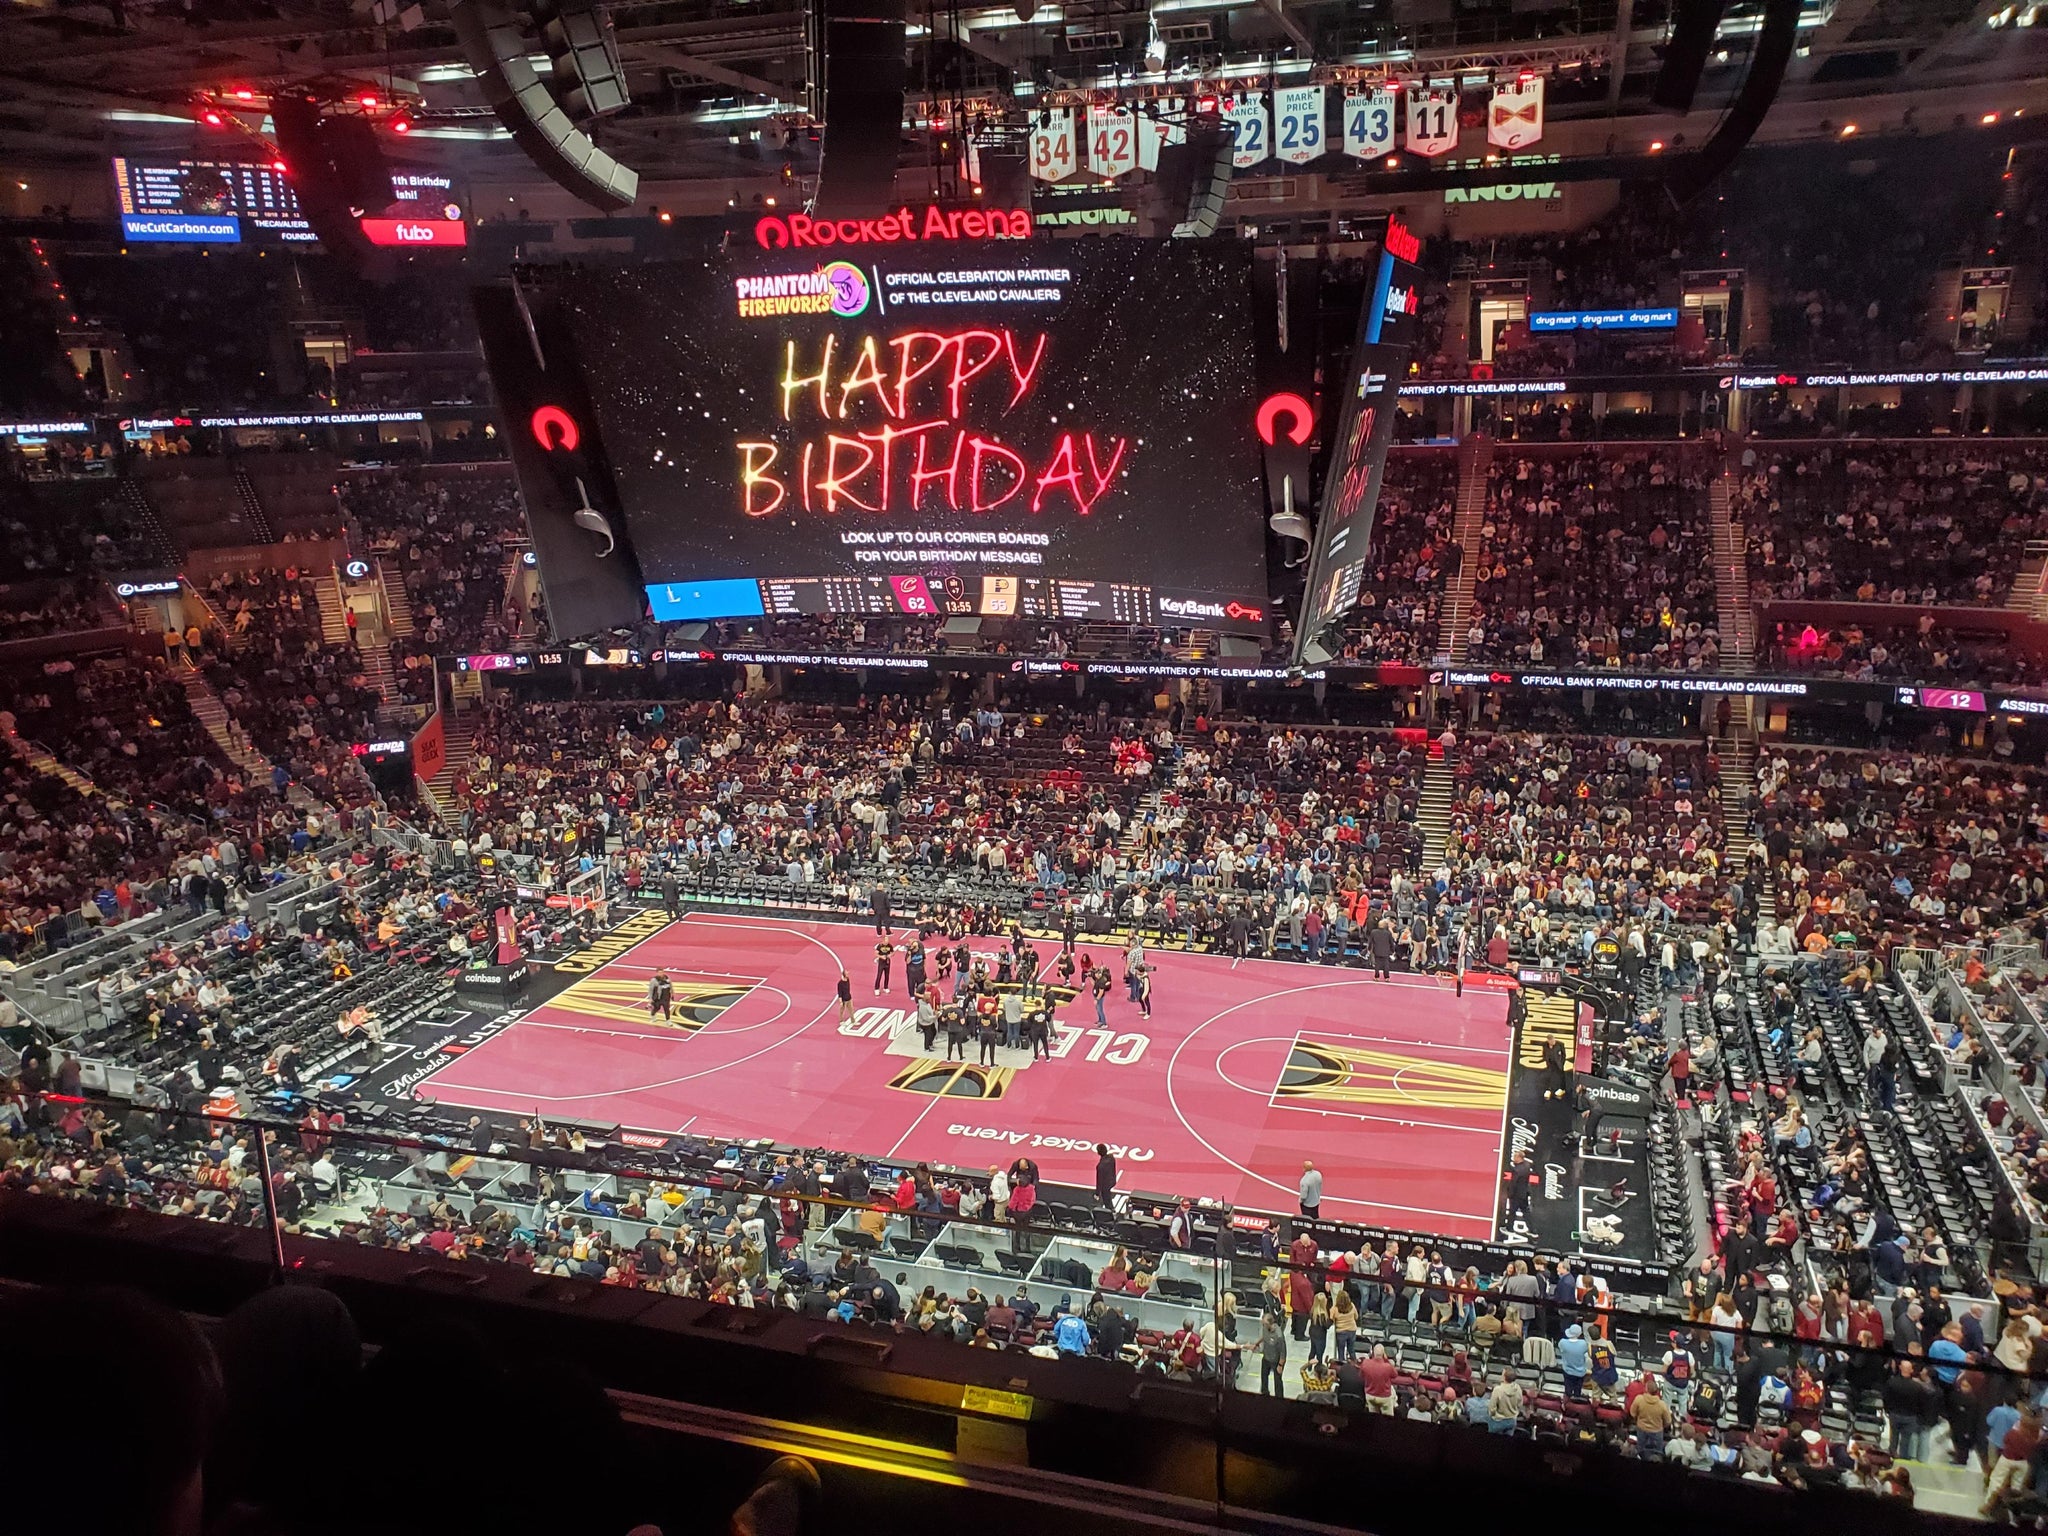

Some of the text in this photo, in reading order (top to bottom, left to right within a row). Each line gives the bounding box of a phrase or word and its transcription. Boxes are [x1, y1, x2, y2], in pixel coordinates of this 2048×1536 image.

[1287, 93, 1313, 103] MARK
[1346, 97, 1394, 108] DAUGHERTY
[1228, 107, 1259, 117] NANCE
[1287, 102, 1313, 112] PRICE
[1350, 109, 1388, 143] 43
[1416, 106, 1447, 139] 11
[1282, 114, 1319, 148] 25
[1036, 133, 1070, 166] 34
[1094, 129, 1129, 162] 42
[409, 176, 450, 189] Birthday
[127, 222, 234, 235] WeCutCarbon.com
[396, 224, 433, 240] fubo
[788, 206, 1031, 247] Rocket Arena
[886, 268, 1071, 286] OFFICIAL CELEBRATION PARTNER
[736, 272, 829, 299] PHANTOM
[889, 288, 1061, 304] OF THE CLEVELAND CAVALIERS
[738, 294, 832, 317] FIREWORKS
[1536, 312, 1672, 326] drug mart drug mart drug mart
[780, 329, 1047, 421] HAPPY
[1739, 376, 1776, 386] KeyBank
[1806, 370, 2026, 385] OFFICIAL BANK PARTNER OF THE CLEVELAND
[1398, 382, 1566, 395] PARTNER OF THE CLEVELAND CAVALIERS
[138, 419, 173, 429] KeyBank
[201, 412, 423, 427] OFFICIAL BANK PARTNER OF THE CLEVELAND CAVALIERS
[39, 422, 88, 432] KNOW.
[736, 420, 1126, 517] BIRTHDAY
[841, 532, 1050, 546] LOOK UP TO OUR CORNER BOARDS
[855, 549, 1042, 564] FOR YOUR BIRTHDAY MESSAGE!
[134, 582, 179, 592] LEXUS
[930, 581, 943, 590] 3Q
[908, 597, 926, 610] 62
[945, 601, 972, 612] 13:55
[990, 600, 1007, 611] 55
[1159, 597, 1225, 617] KeyBank
[495, 656, 510, 667] 62
[539, 654, 562, 664] 13:55
[668, 651, 700, 661] KeyBank
[722, 653, 928, 668] OFFICIAL BANK PARTNER OF THE CLEVELAND CAVALIERS
[1029, 661, 1061, 671] KeyBank
[1088, 664, 1273, 678] OFFICIAL BANK PARTNER OF THE CLEVELAND
[1450, 671, 1489, 683] KeyBank
[1522, 676, 1807, 694] OFFICIAL BANK PARTNER OF THE CLEVELAND CAVALIERS
[1899, 687, 1915, 695] FG%
[1901, 696, 1913, 704] 48
[1950, 694, 1971, 707] 12
[369, 741, 405, 752] KENDA
[554, 909, 677, 974] CAVALIERS
[1599, 943, 1617, 953] 13:55
[465, 973, 501, 984] coinbase
[460, 1008, 528, 1045] ULTRA
[381, 1053, 451, 1099] Michelob
[946, 1123, 1030, 1145] Arena
[1702, 1386, 1713, 1400] 10
